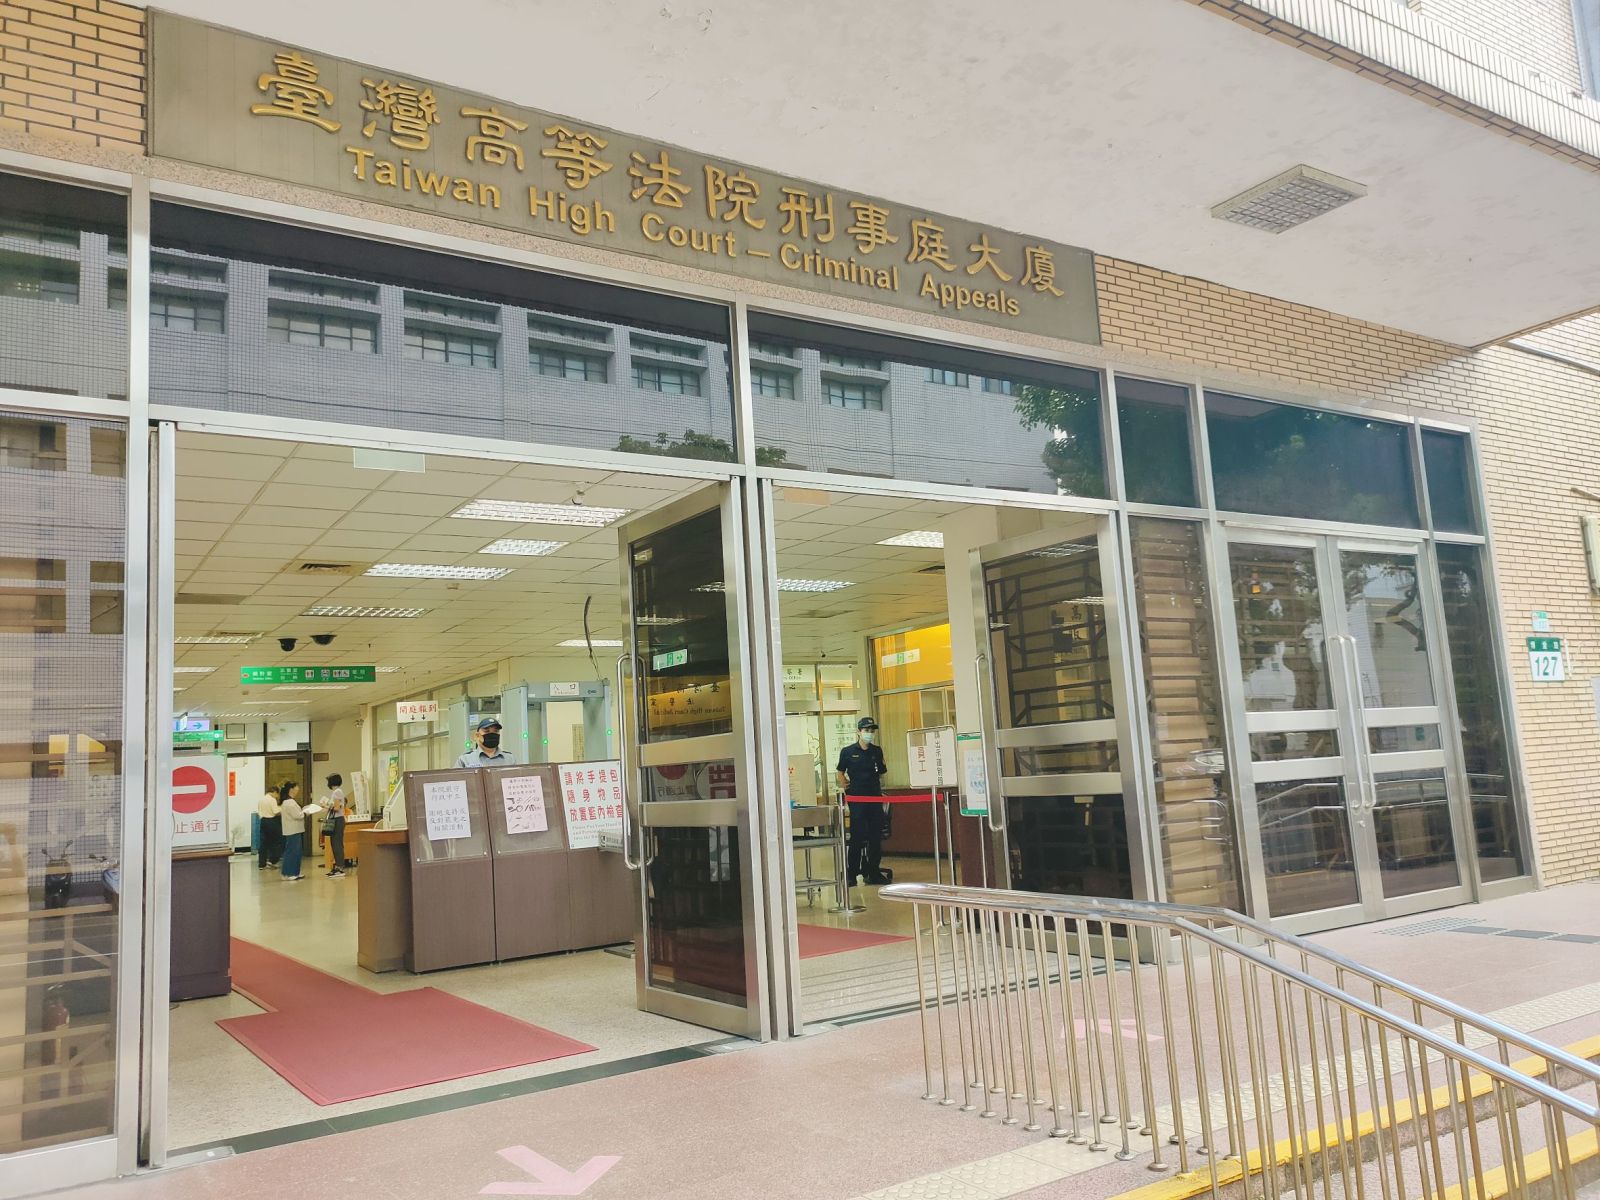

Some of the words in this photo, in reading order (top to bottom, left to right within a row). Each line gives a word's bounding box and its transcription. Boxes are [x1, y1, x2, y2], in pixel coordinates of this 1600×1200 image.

[250, 51, 1065, 297] 臺灣高等法院刑事庭大廈
[346, 145, 501, 208] Taiwan
[528, 186, 616, 235] High
[641, 213, 736, 258] Court
[780, 241, 899, 291] Criminal
[920, 272, 1020, 316] Appeals
[1535, 656, 1557, 676] 127
[399, 702, 437, 714] 開庭報到
[564, 769, 619, 786] 請將手提包
[567, 786, 621, 804] 隨身物品
